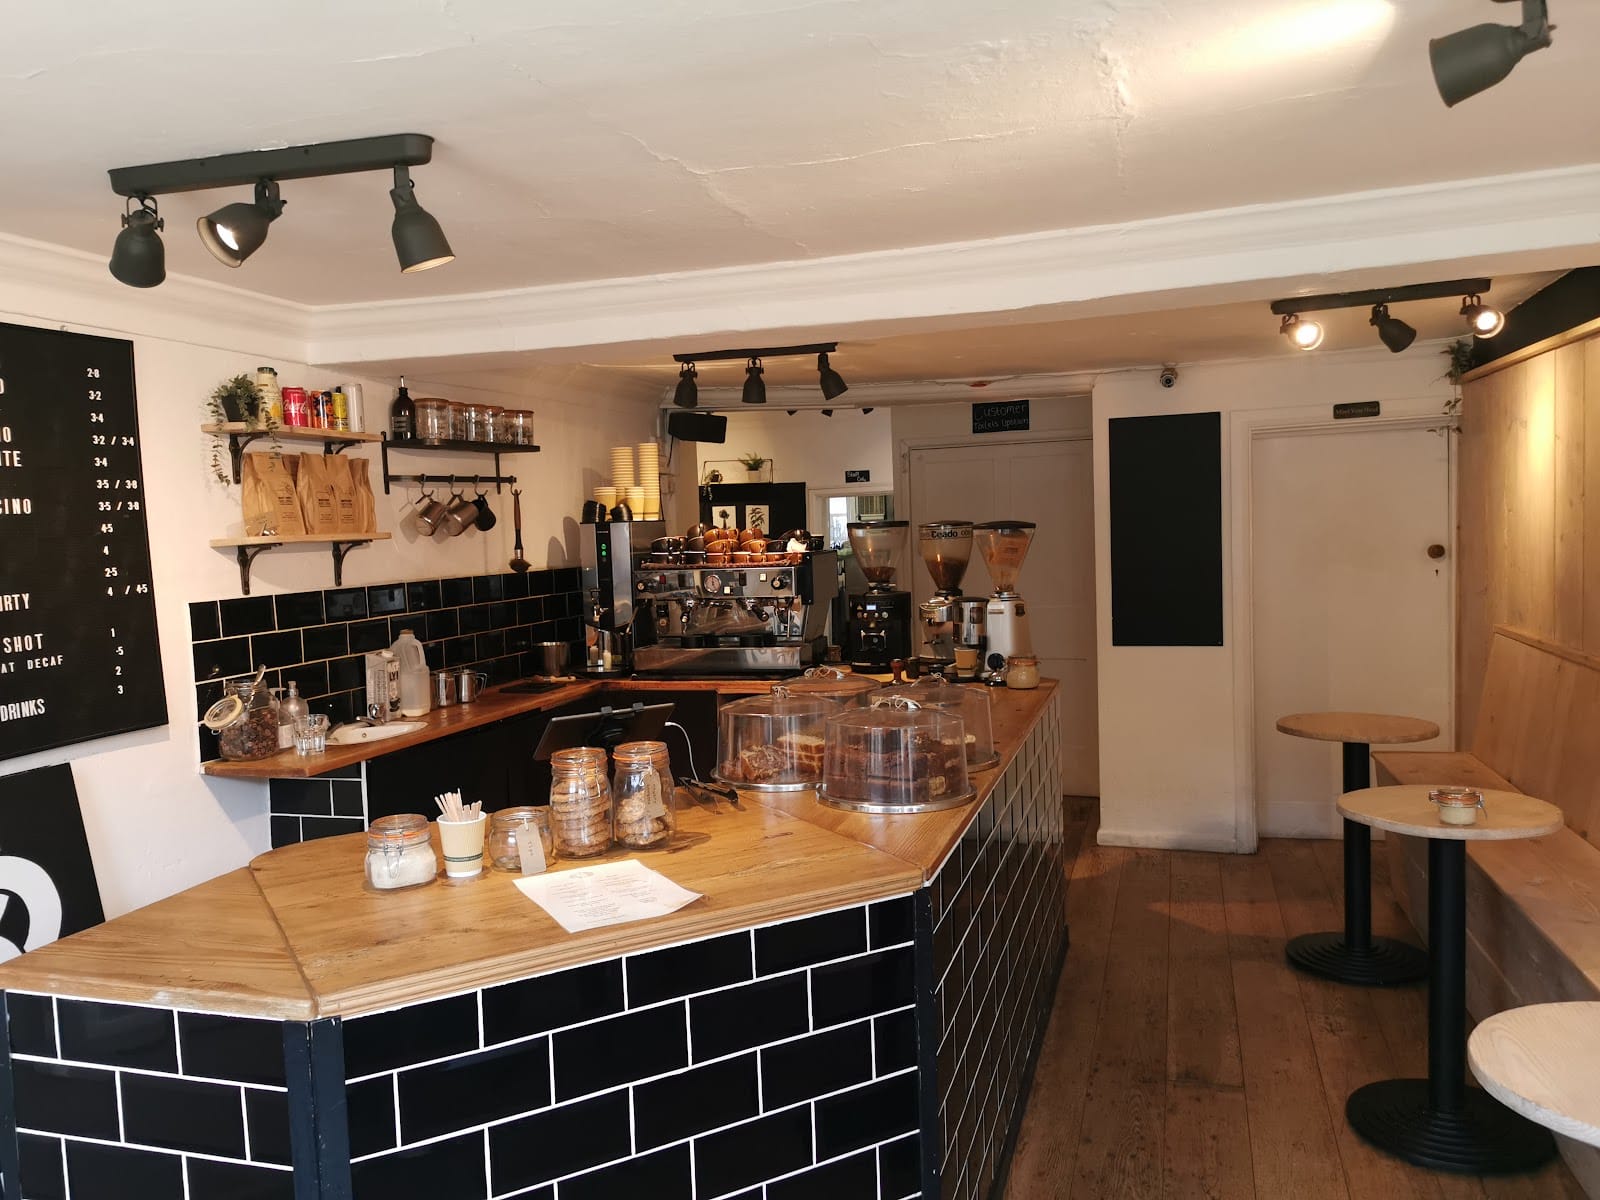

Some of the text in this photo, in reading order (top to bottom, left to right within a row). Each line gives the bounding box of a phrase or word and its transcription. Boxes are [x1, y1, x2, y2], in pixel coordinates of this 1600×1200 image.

[0, 427, 11, 442] O
[103, 545, 109, 555] 4
[107, 587, 113, 596] 4
[110, 628, 116, 638] 1
[3, 633, 43, 653] SHOT
[27, 655, 63, 670] DECAF
[115, 666, 122, 675] 2
[117, 685, 124, 695] 3
[0, 699, 46, 722] DRINKS
